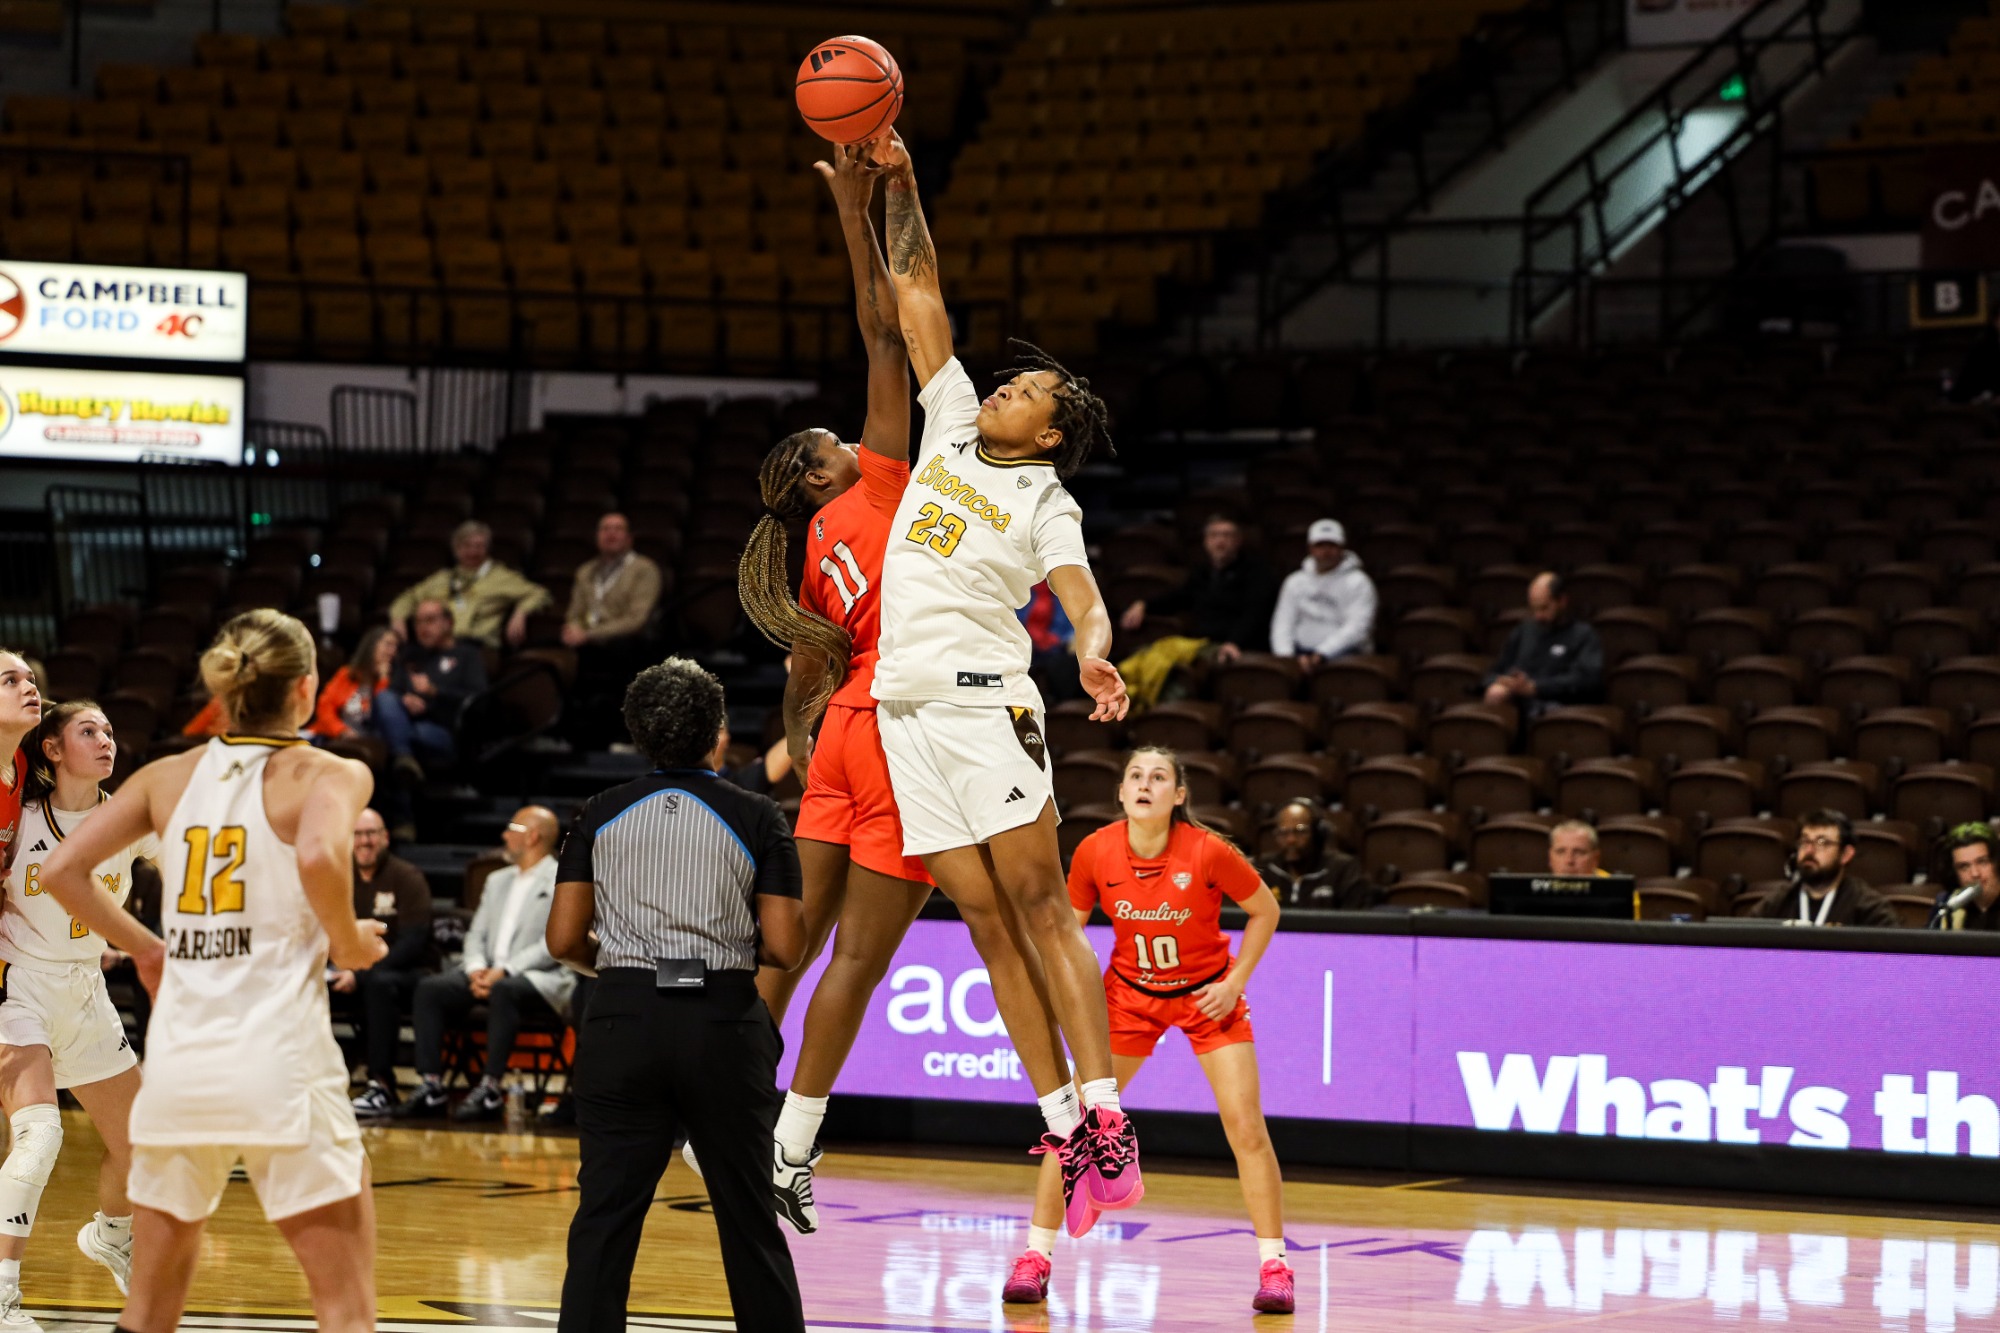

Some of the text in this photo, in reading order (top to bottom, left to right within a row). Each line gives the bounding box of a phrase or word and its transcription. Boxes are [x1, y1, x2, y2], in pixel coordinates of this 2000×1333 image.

[39, 278, 236, 308] CAMPBELL
[1933, 280, 1962, 313] B
[40, 306, 140, 331] FORD
[916, 454, 1013, 533] Broncos
[905, 501, 968, 558] 23
[819, 539, 869, 616] 11
[177, 825, 247, 915] 12
[1114, 899, 1192, 926] Bowling
[168, 928, 252, 960] CARLSON
[1133, 931, 1181, 970] 10
[922, 1048, 1023, 1081] credit
[1456, 1051, 2000, 1157] What's th
